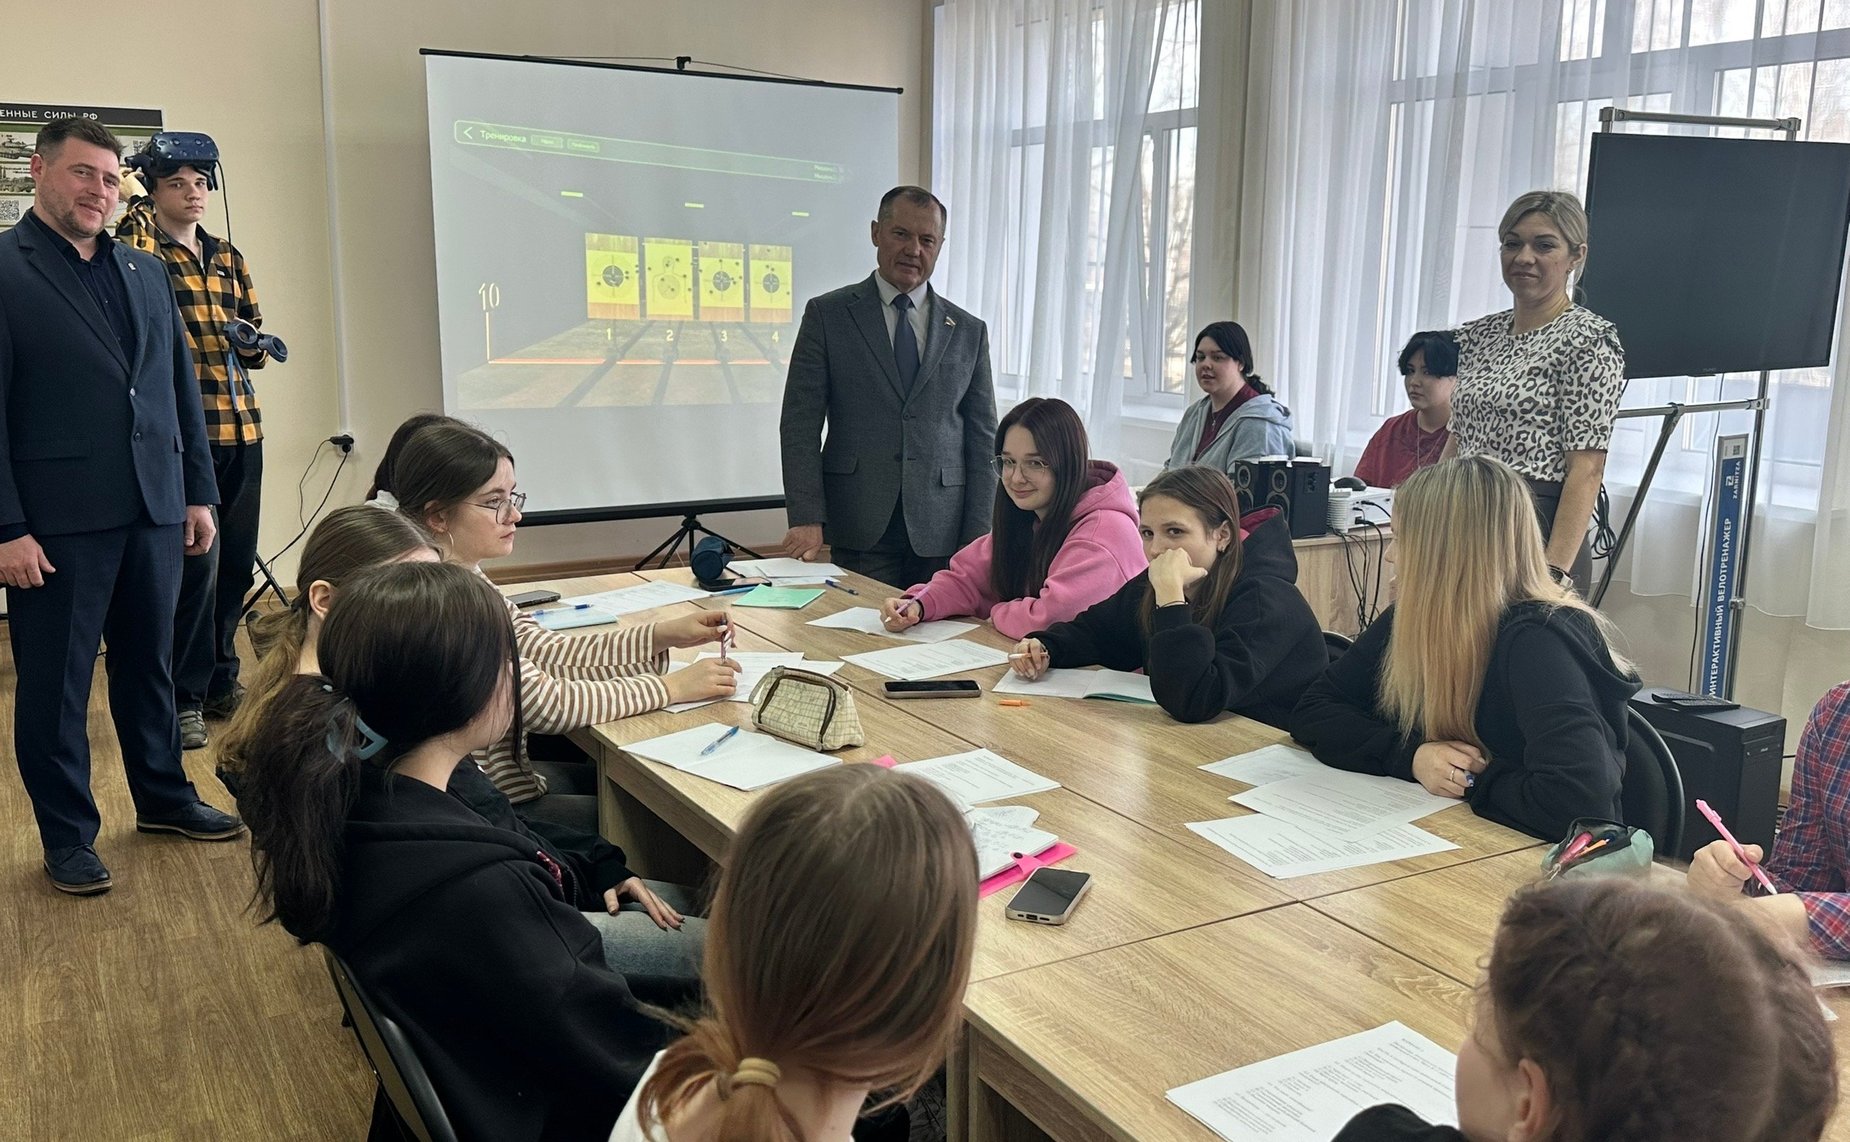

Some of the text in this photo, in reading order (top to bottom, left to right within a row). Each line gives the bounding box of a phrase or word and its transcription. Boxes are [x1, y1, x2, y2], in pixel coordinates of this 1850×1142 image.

[44, 111, 76, 119] СИЛЫ
[83, 112, 98, 120] РФ
[480, 130, 527, 143] Тренировка
[479, 283, 500, 311] 10
[606, 328, 780, 343] 1 2 3 4
[1732, 460, 1742, 500] ZARNITZA
[1703, 518, 1732, 699] ИНТЕРАКТИВНЫЙ ВЕЛОТРЕНАЖЕР
